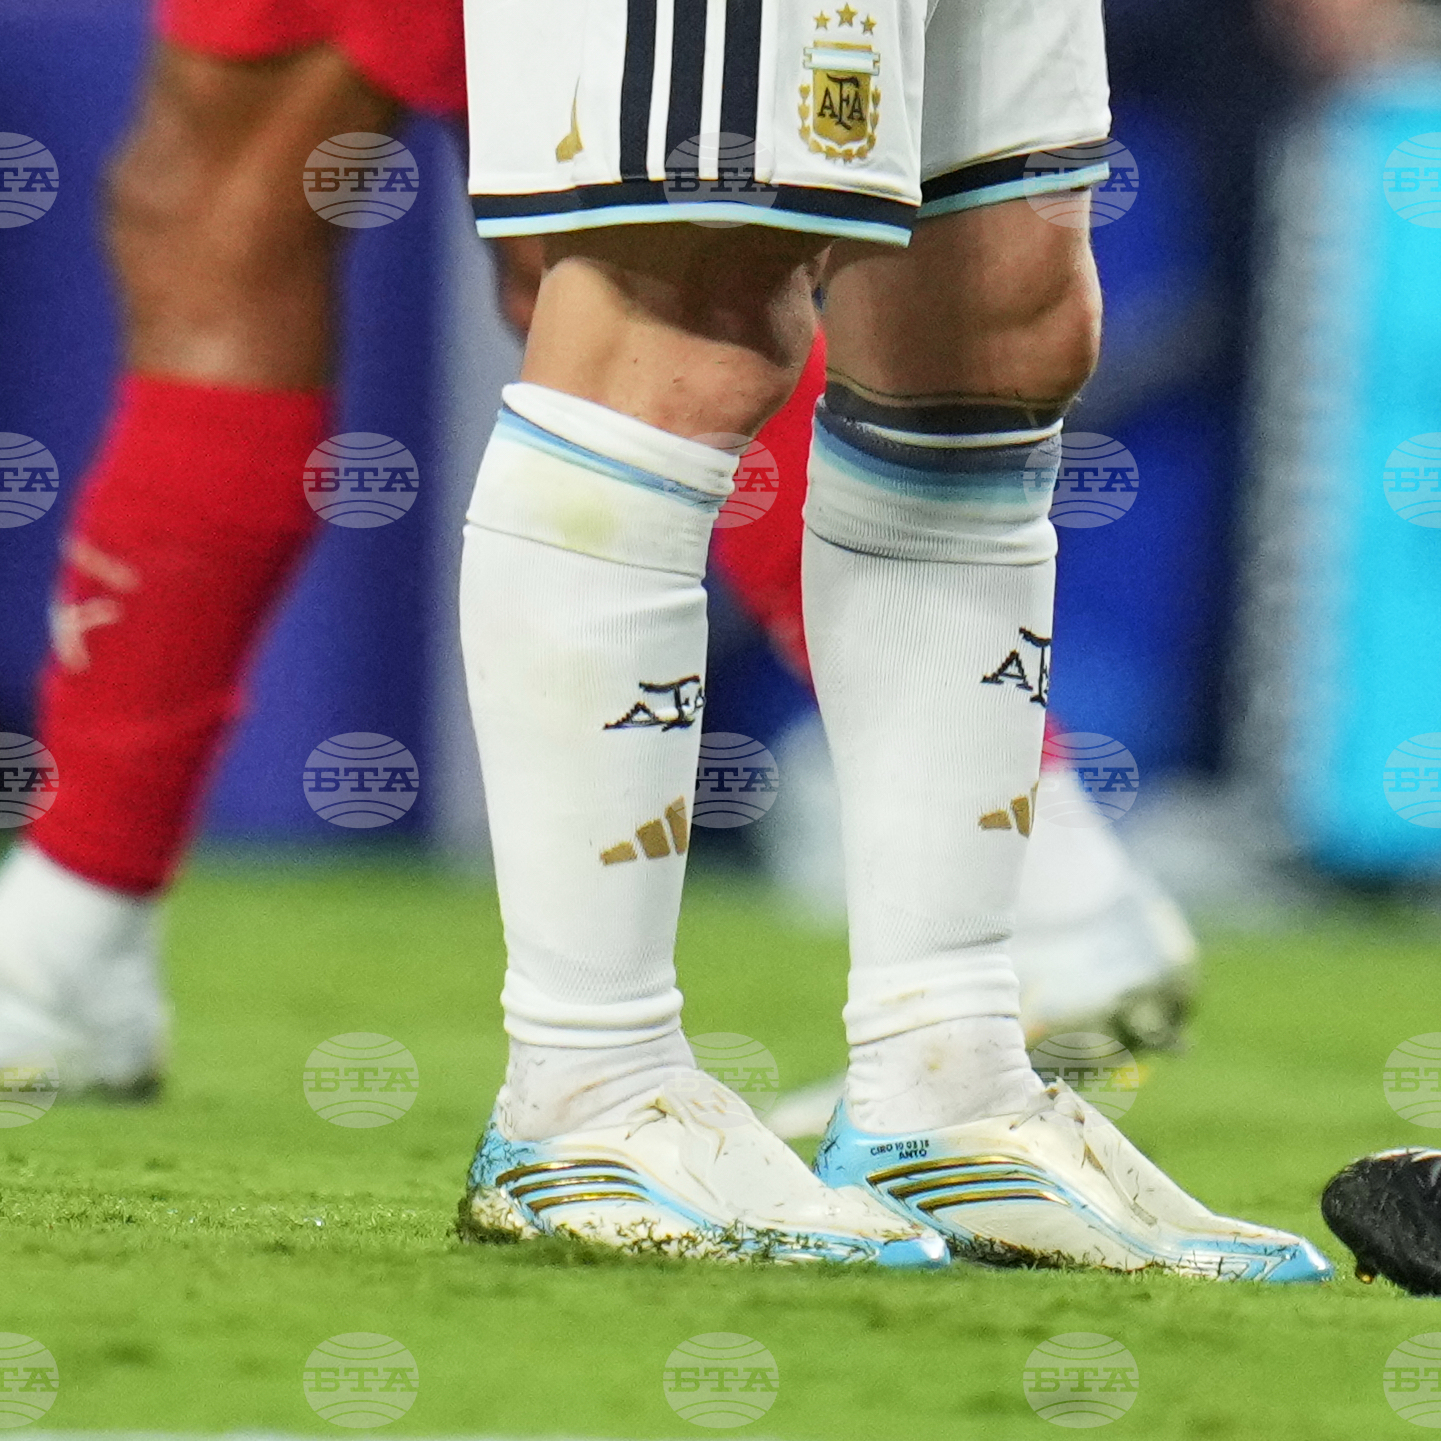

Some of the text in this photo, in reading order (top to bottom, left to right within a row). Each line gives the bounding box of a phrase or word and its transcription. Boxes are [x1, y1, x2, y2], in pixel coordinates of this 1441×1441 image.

[817, 72, 867, 131] AFA
[870, 1144, 893, 1156] CIRO
[898, 1148, 927, 1160] ANTO
